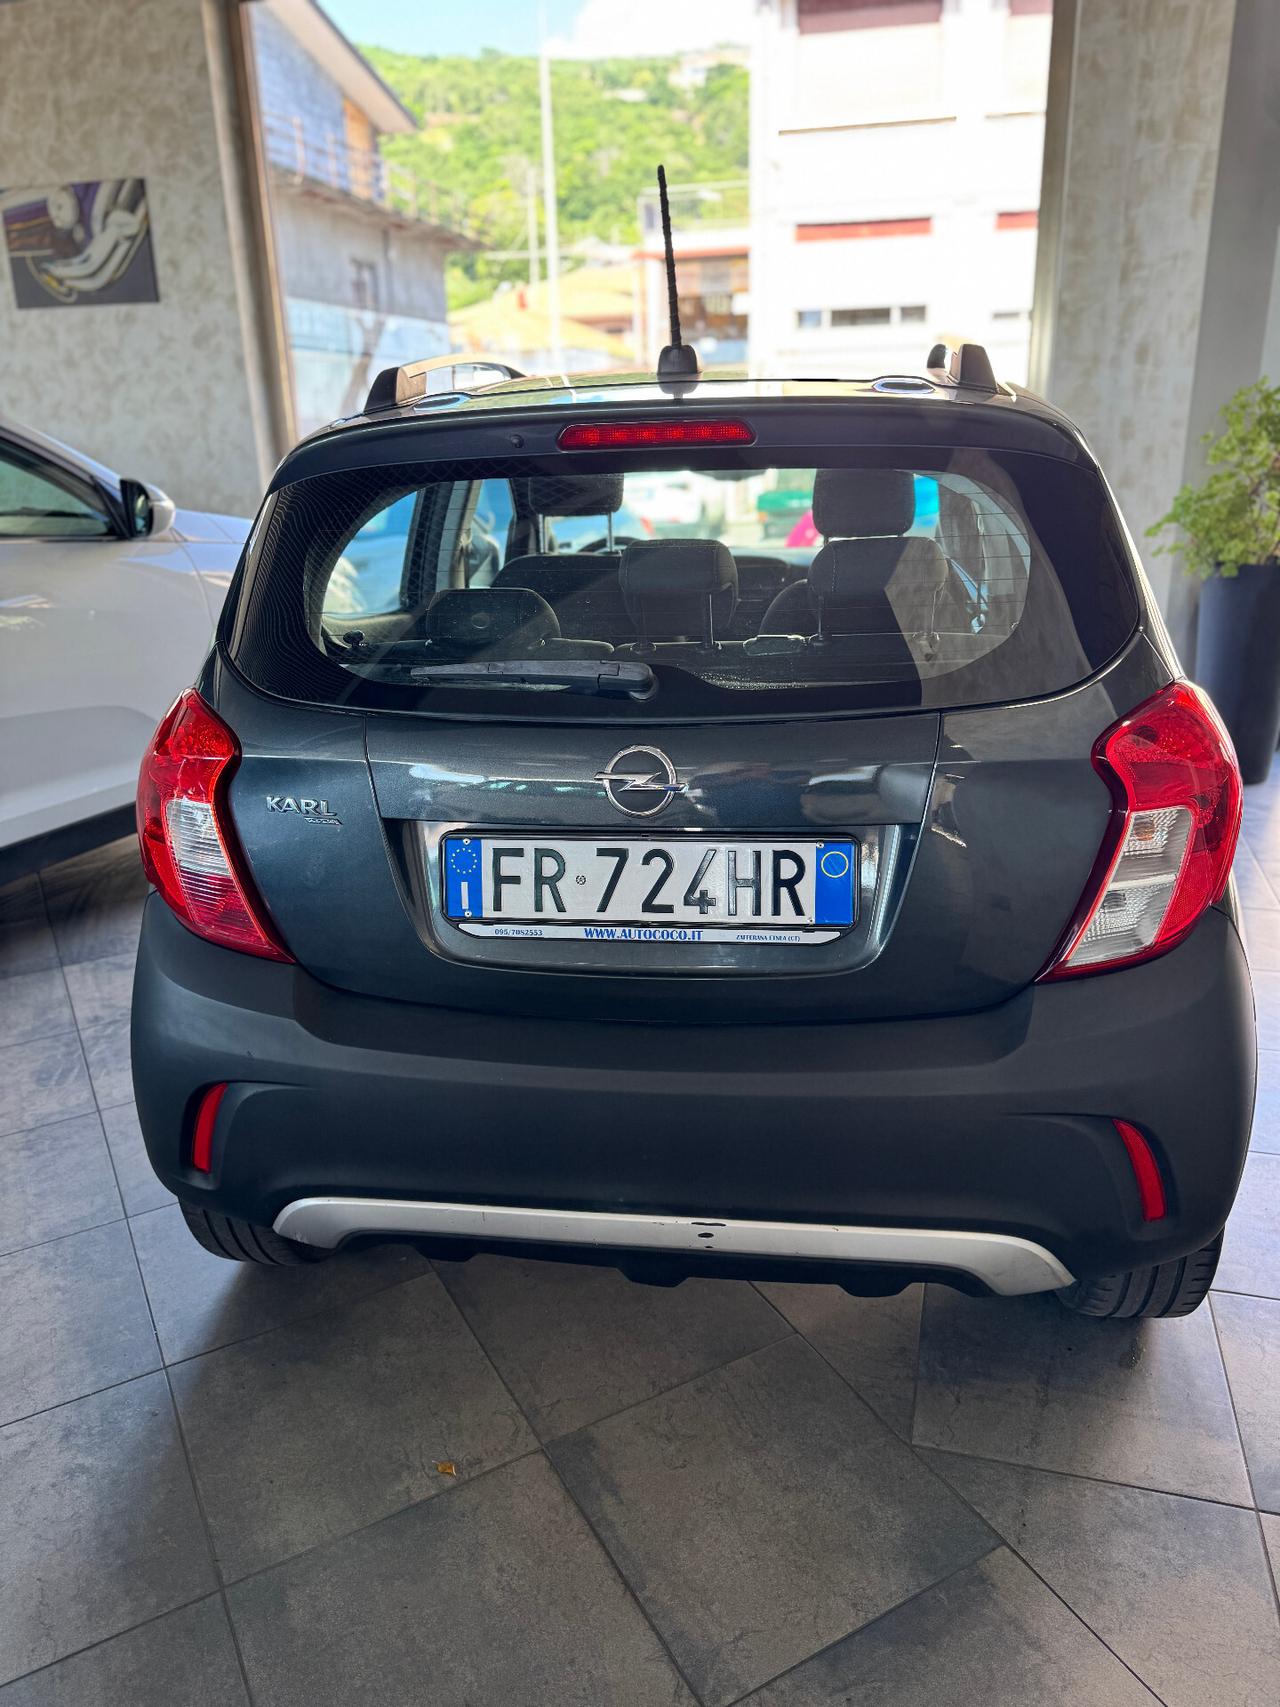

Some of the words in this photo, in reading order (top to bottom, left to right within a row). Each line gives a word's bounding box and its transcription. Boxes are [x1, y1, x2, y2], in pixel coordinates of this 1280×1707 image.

[266, 796, 338, 816] KARL
[492, 847, 567, 913] FR
[584, 927, 704, 940] WWW.AUTOCOCO.IT
